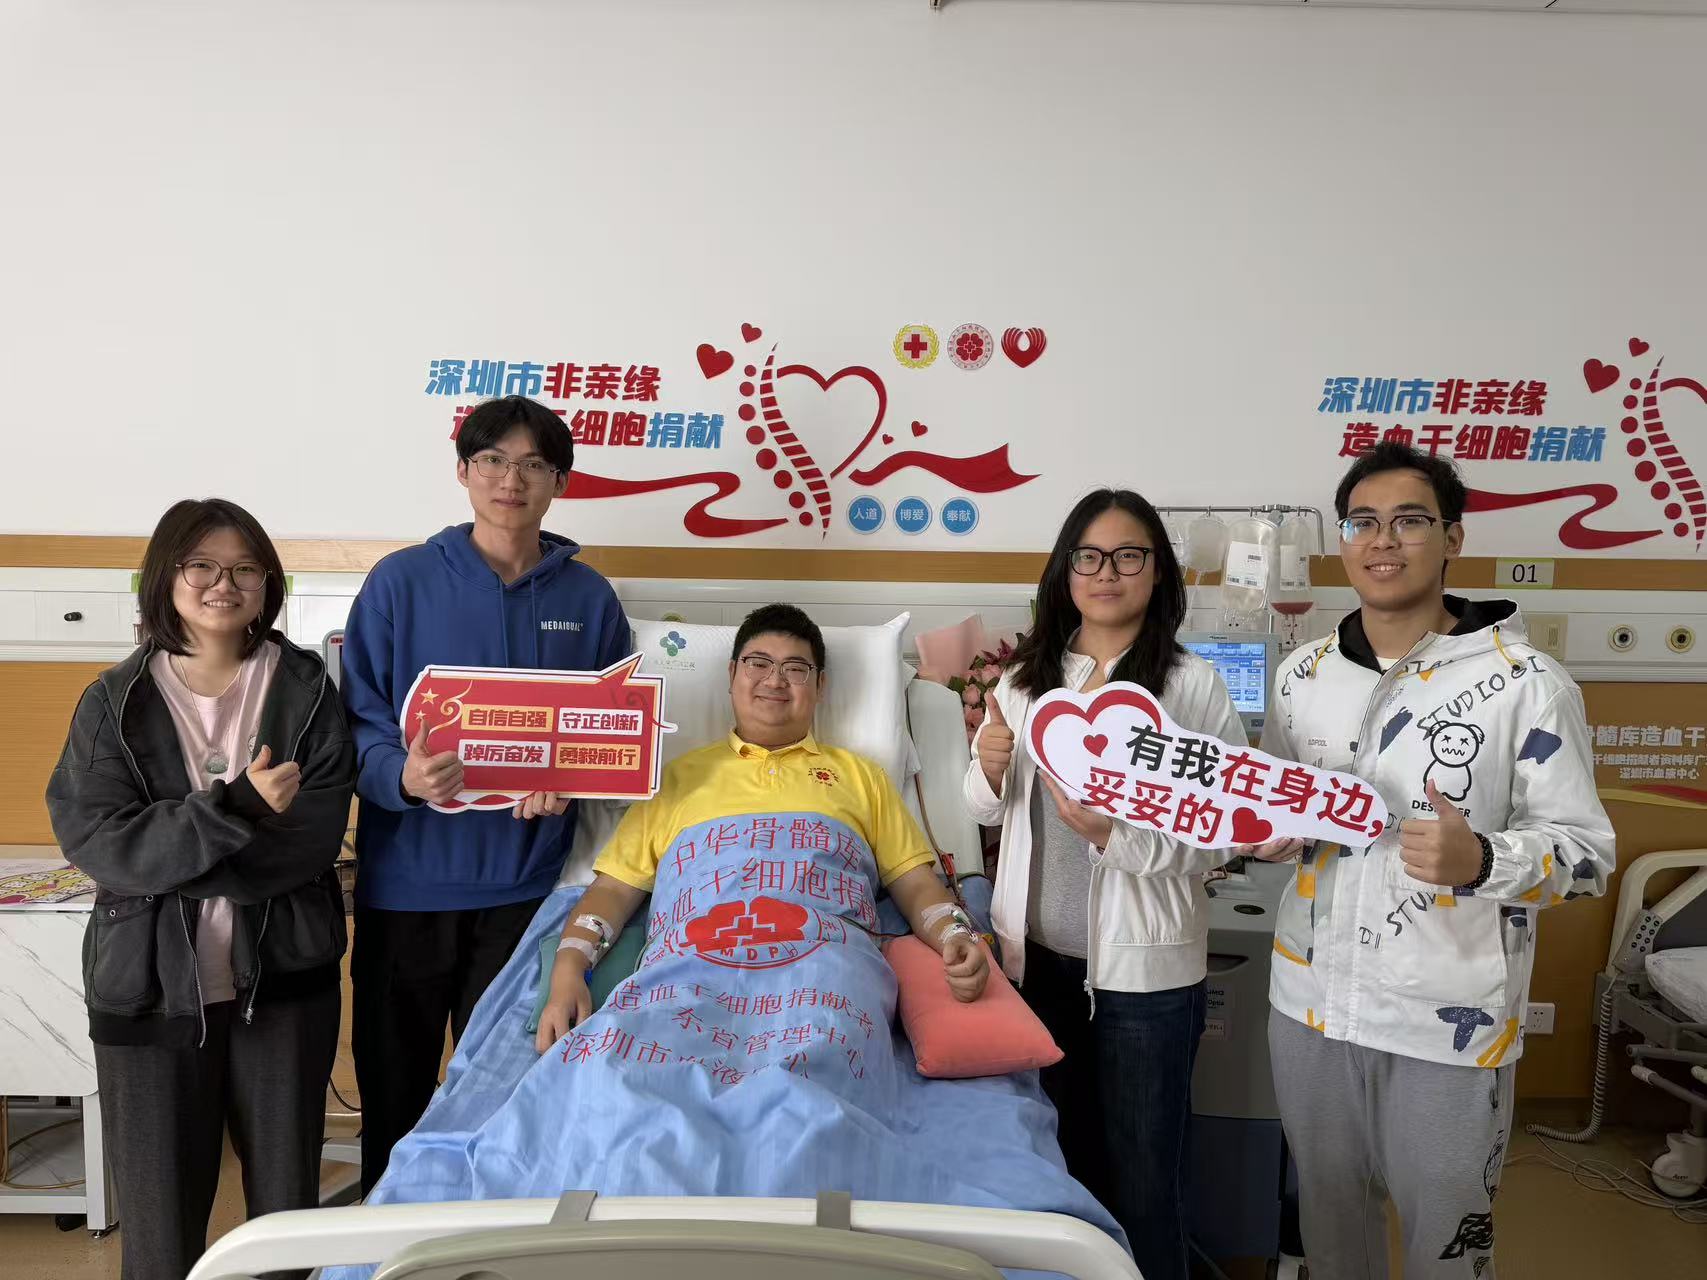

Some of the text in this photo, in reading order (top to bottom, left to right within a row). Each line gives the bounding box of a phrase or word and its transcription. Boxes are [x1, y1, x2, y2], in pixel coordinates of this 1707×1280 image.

[424, 359, 661, 402] 深圳市非亲缘
[1317, 376, 1548, 417] 深圳市非亲缘
[449, 405, 725, 450] 细胞捐献
[853, 507, 972, 522] 人道 博爱 奉献
[1511, 563, 1539, 584] 01
[467, 708, 639, 732] 自信自强 守正创新
[462, 743, 637, 767] 踔厉奋发 勇毅前行
[1081, 766, 1224, 844] 妥妥的
